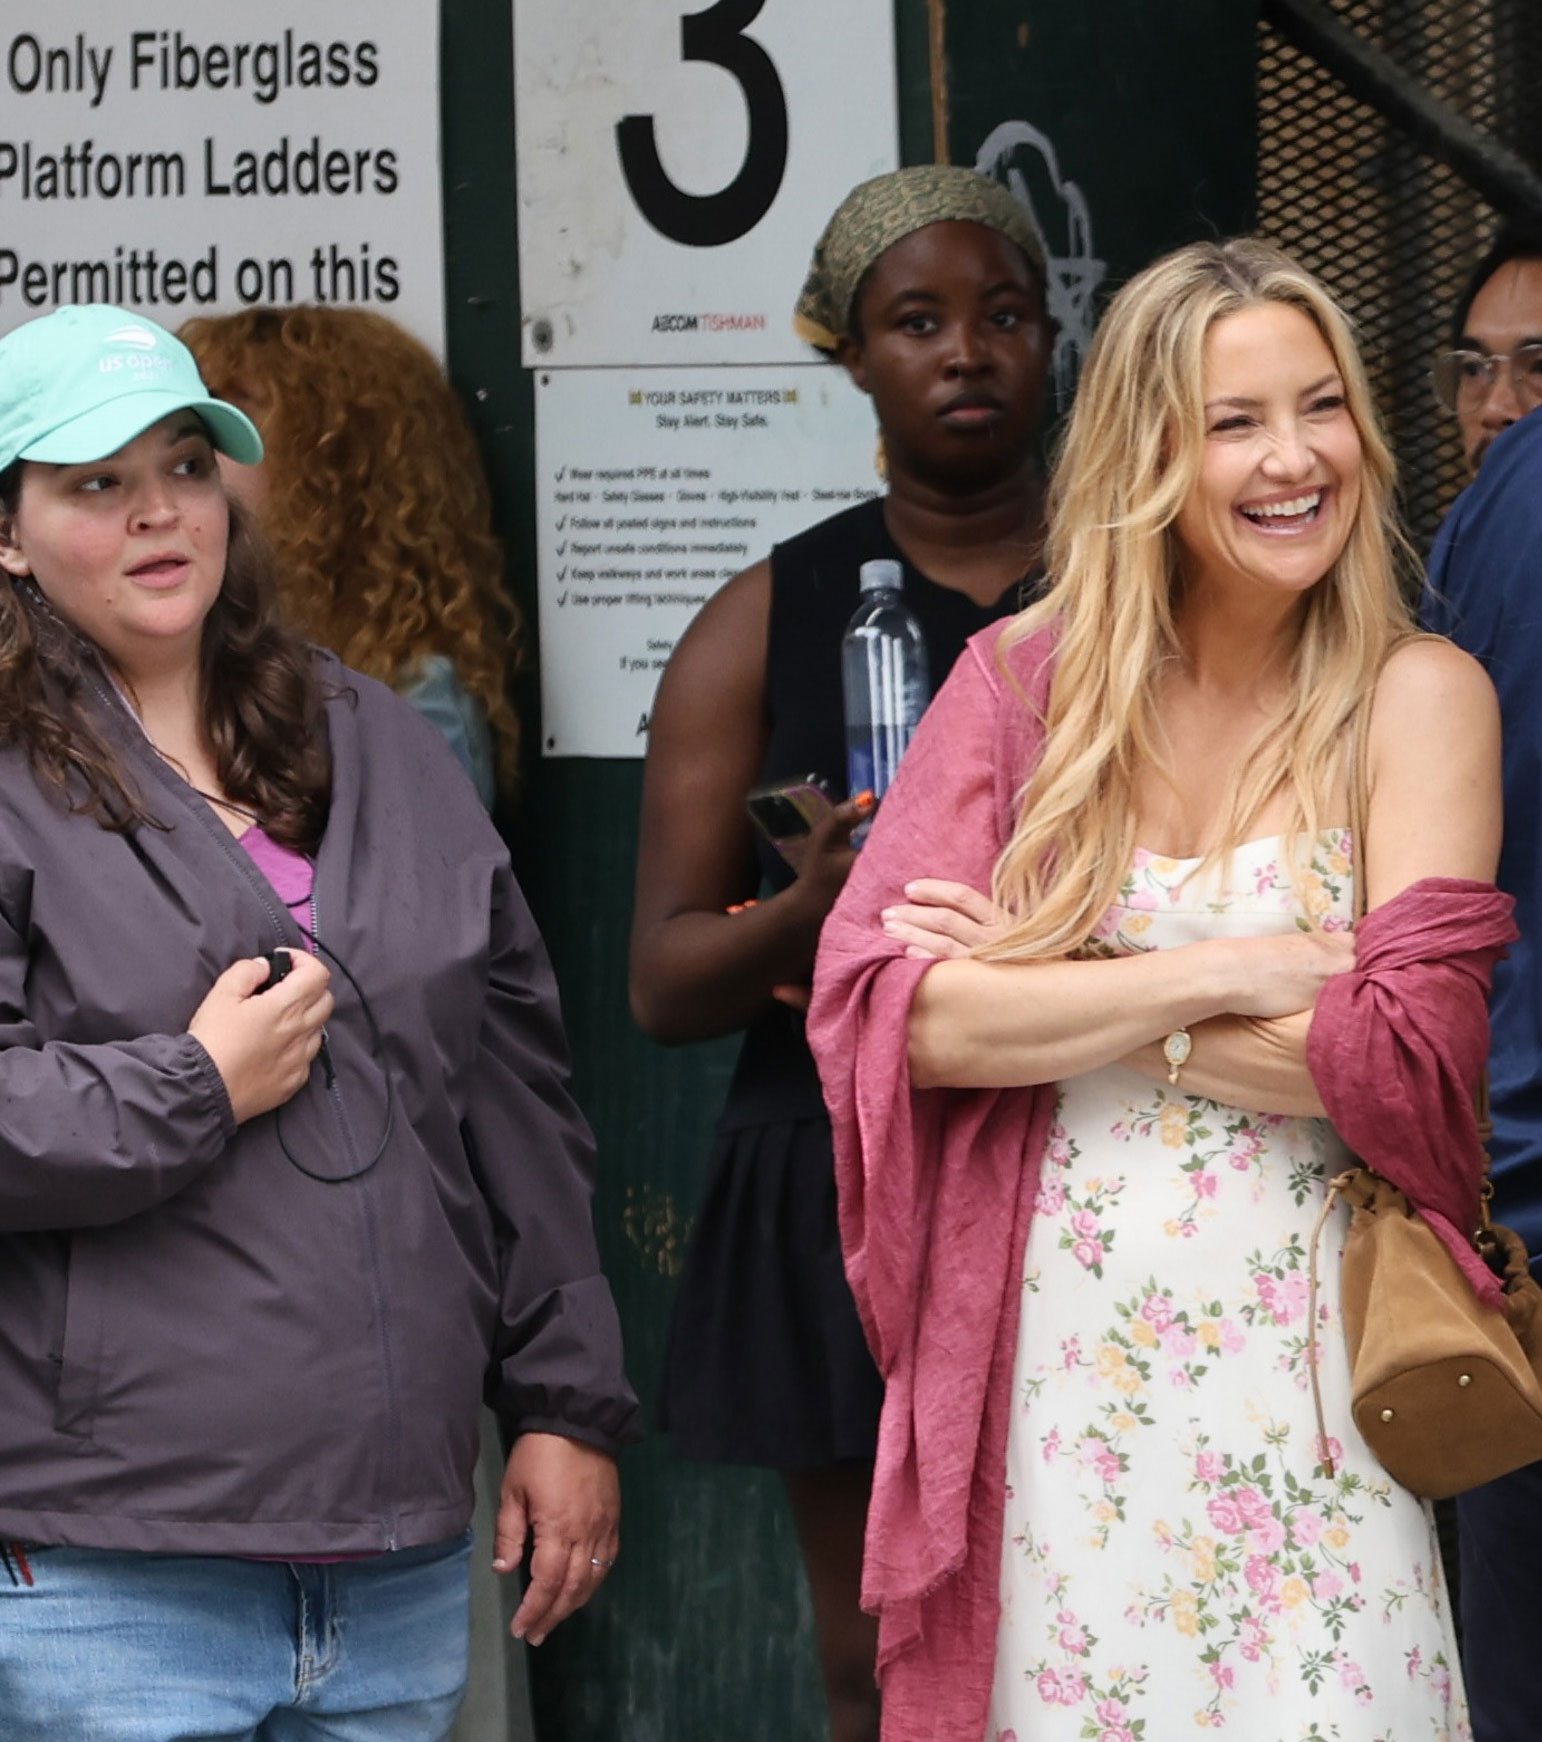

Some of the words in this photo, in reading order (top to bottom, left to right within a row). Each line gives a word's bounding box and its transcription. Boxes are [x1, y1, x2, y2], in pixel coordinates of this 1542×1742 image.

[8, 32, 114, 108] Only
[130, 29, 379, 105] Fiberglass
[615, 0, 789, 248] 3
[0, 139, 185, 201] Platform
[204, 136, 399, 197] Ladders
[0, 246, 218, 307] Permitted
[236, 258, 294, 304] on
[312, 243, 400, 303] this
[651, 313, 698, 333] AECOM
[702, 312, 766, 332] TISHMAN
[645, 390, 676, 406] YOUR
[679, 390, 723, 405] SAFETY
[726, 390, 781, 405] MATTERS
[656, 413, 681, 432] Stay
[714, 413, 739, 430] Stay
[629, 658, 649, 673] you
